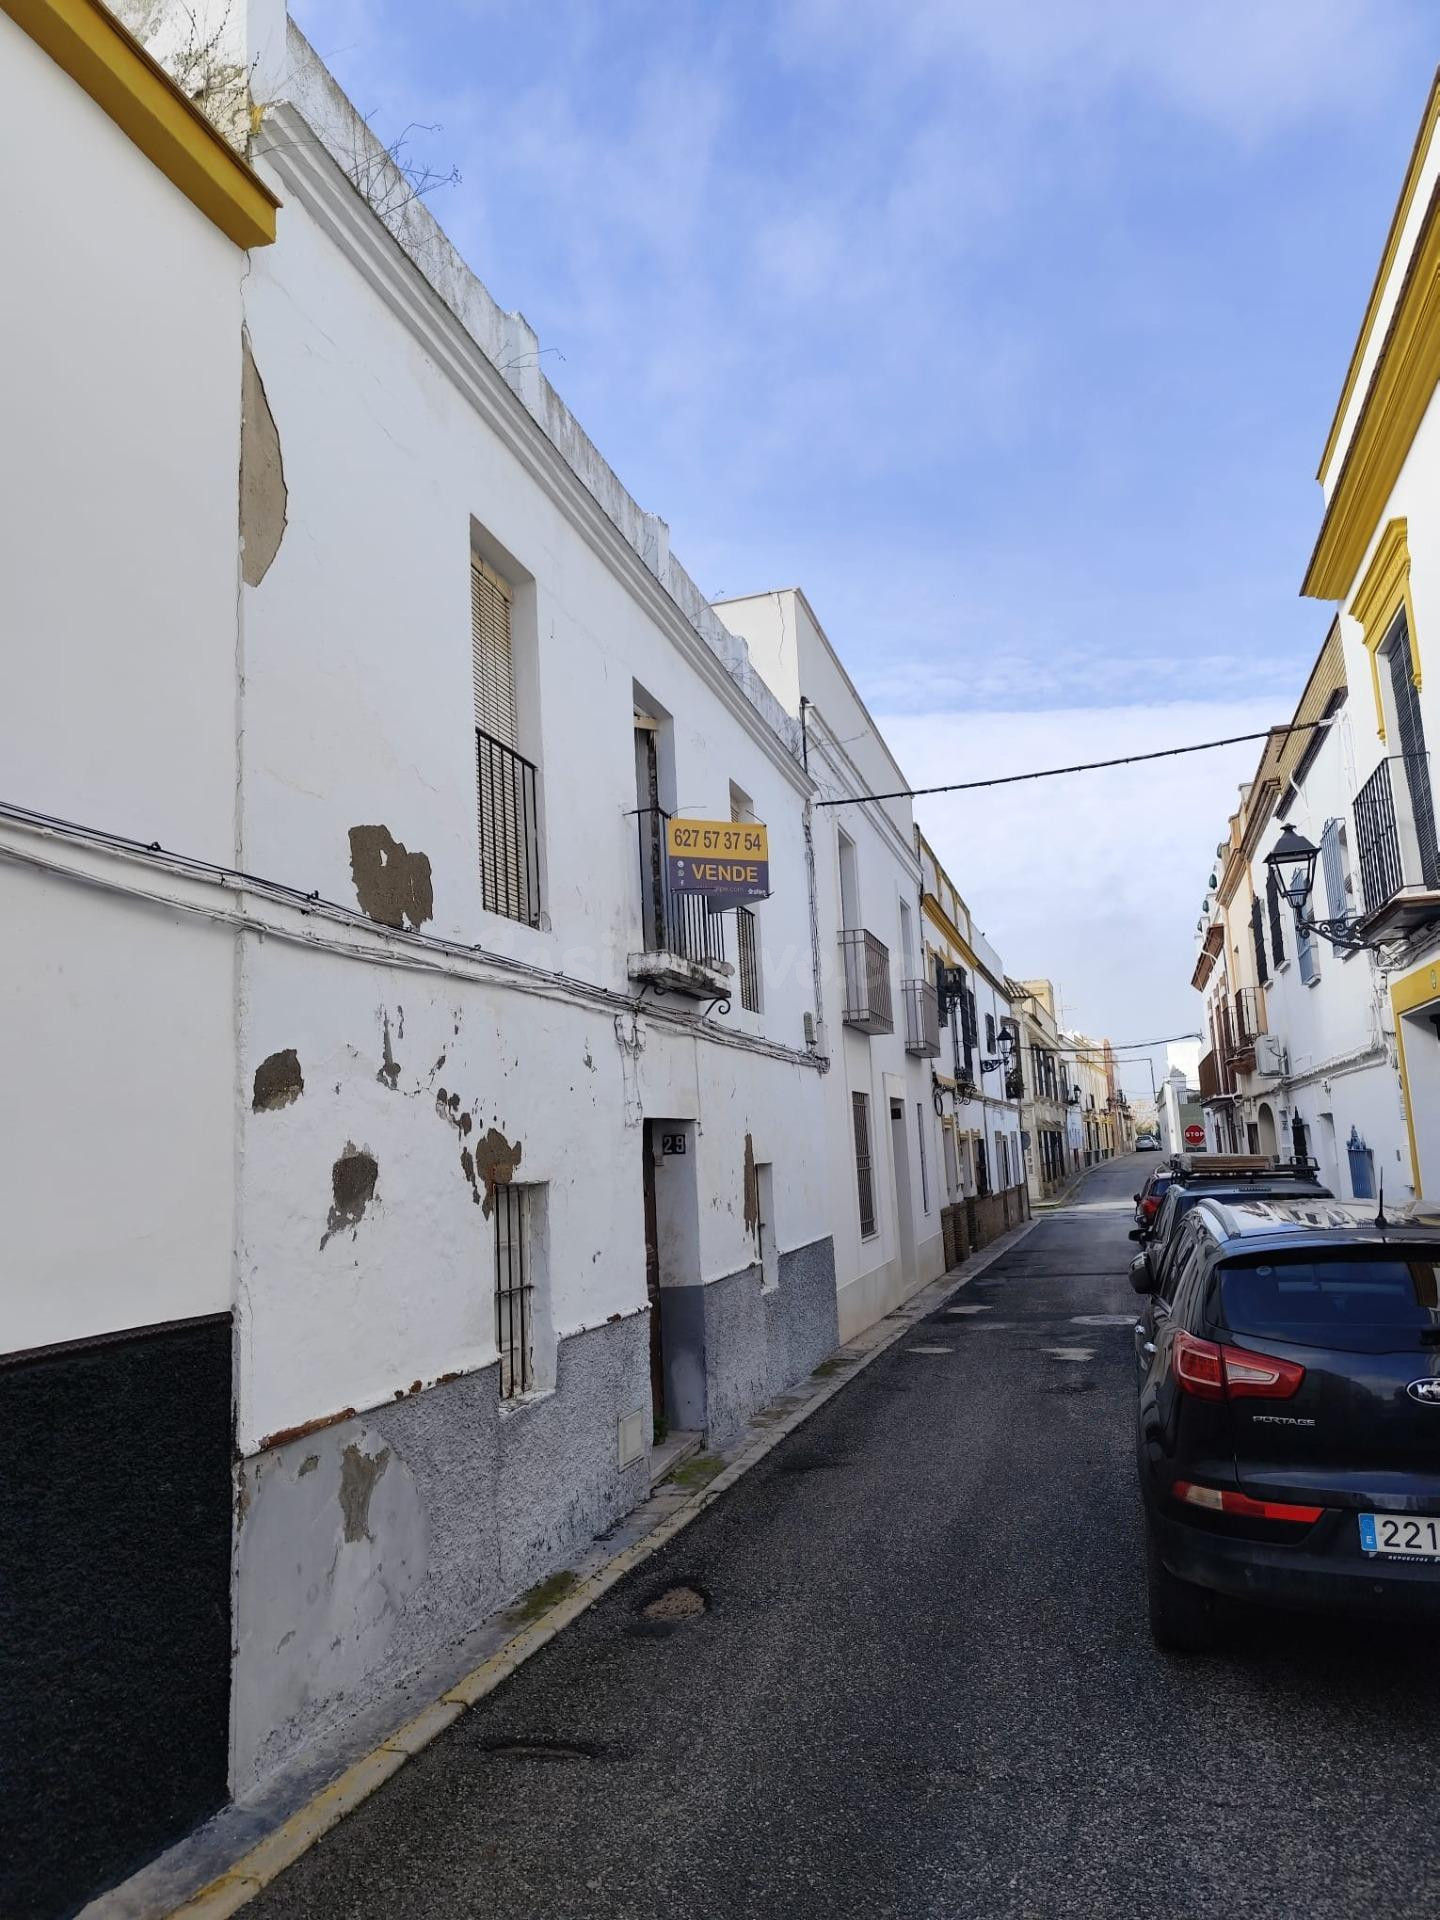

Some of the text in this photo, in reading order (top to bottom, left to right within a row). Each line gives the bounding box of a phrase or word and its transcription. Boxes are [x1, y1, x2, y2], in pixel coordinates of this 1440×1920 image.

[674, 828, 761, 852] 627 57 37 54
[691, 863, 759, 883] VENDE
[663, 1136, 684, 1153] 29
[1252, 1415, 1316, 1427] PORTAGE
[1366, 1535, 1374, 1544] E
[1382, 1520, 1437, 1550] 221
